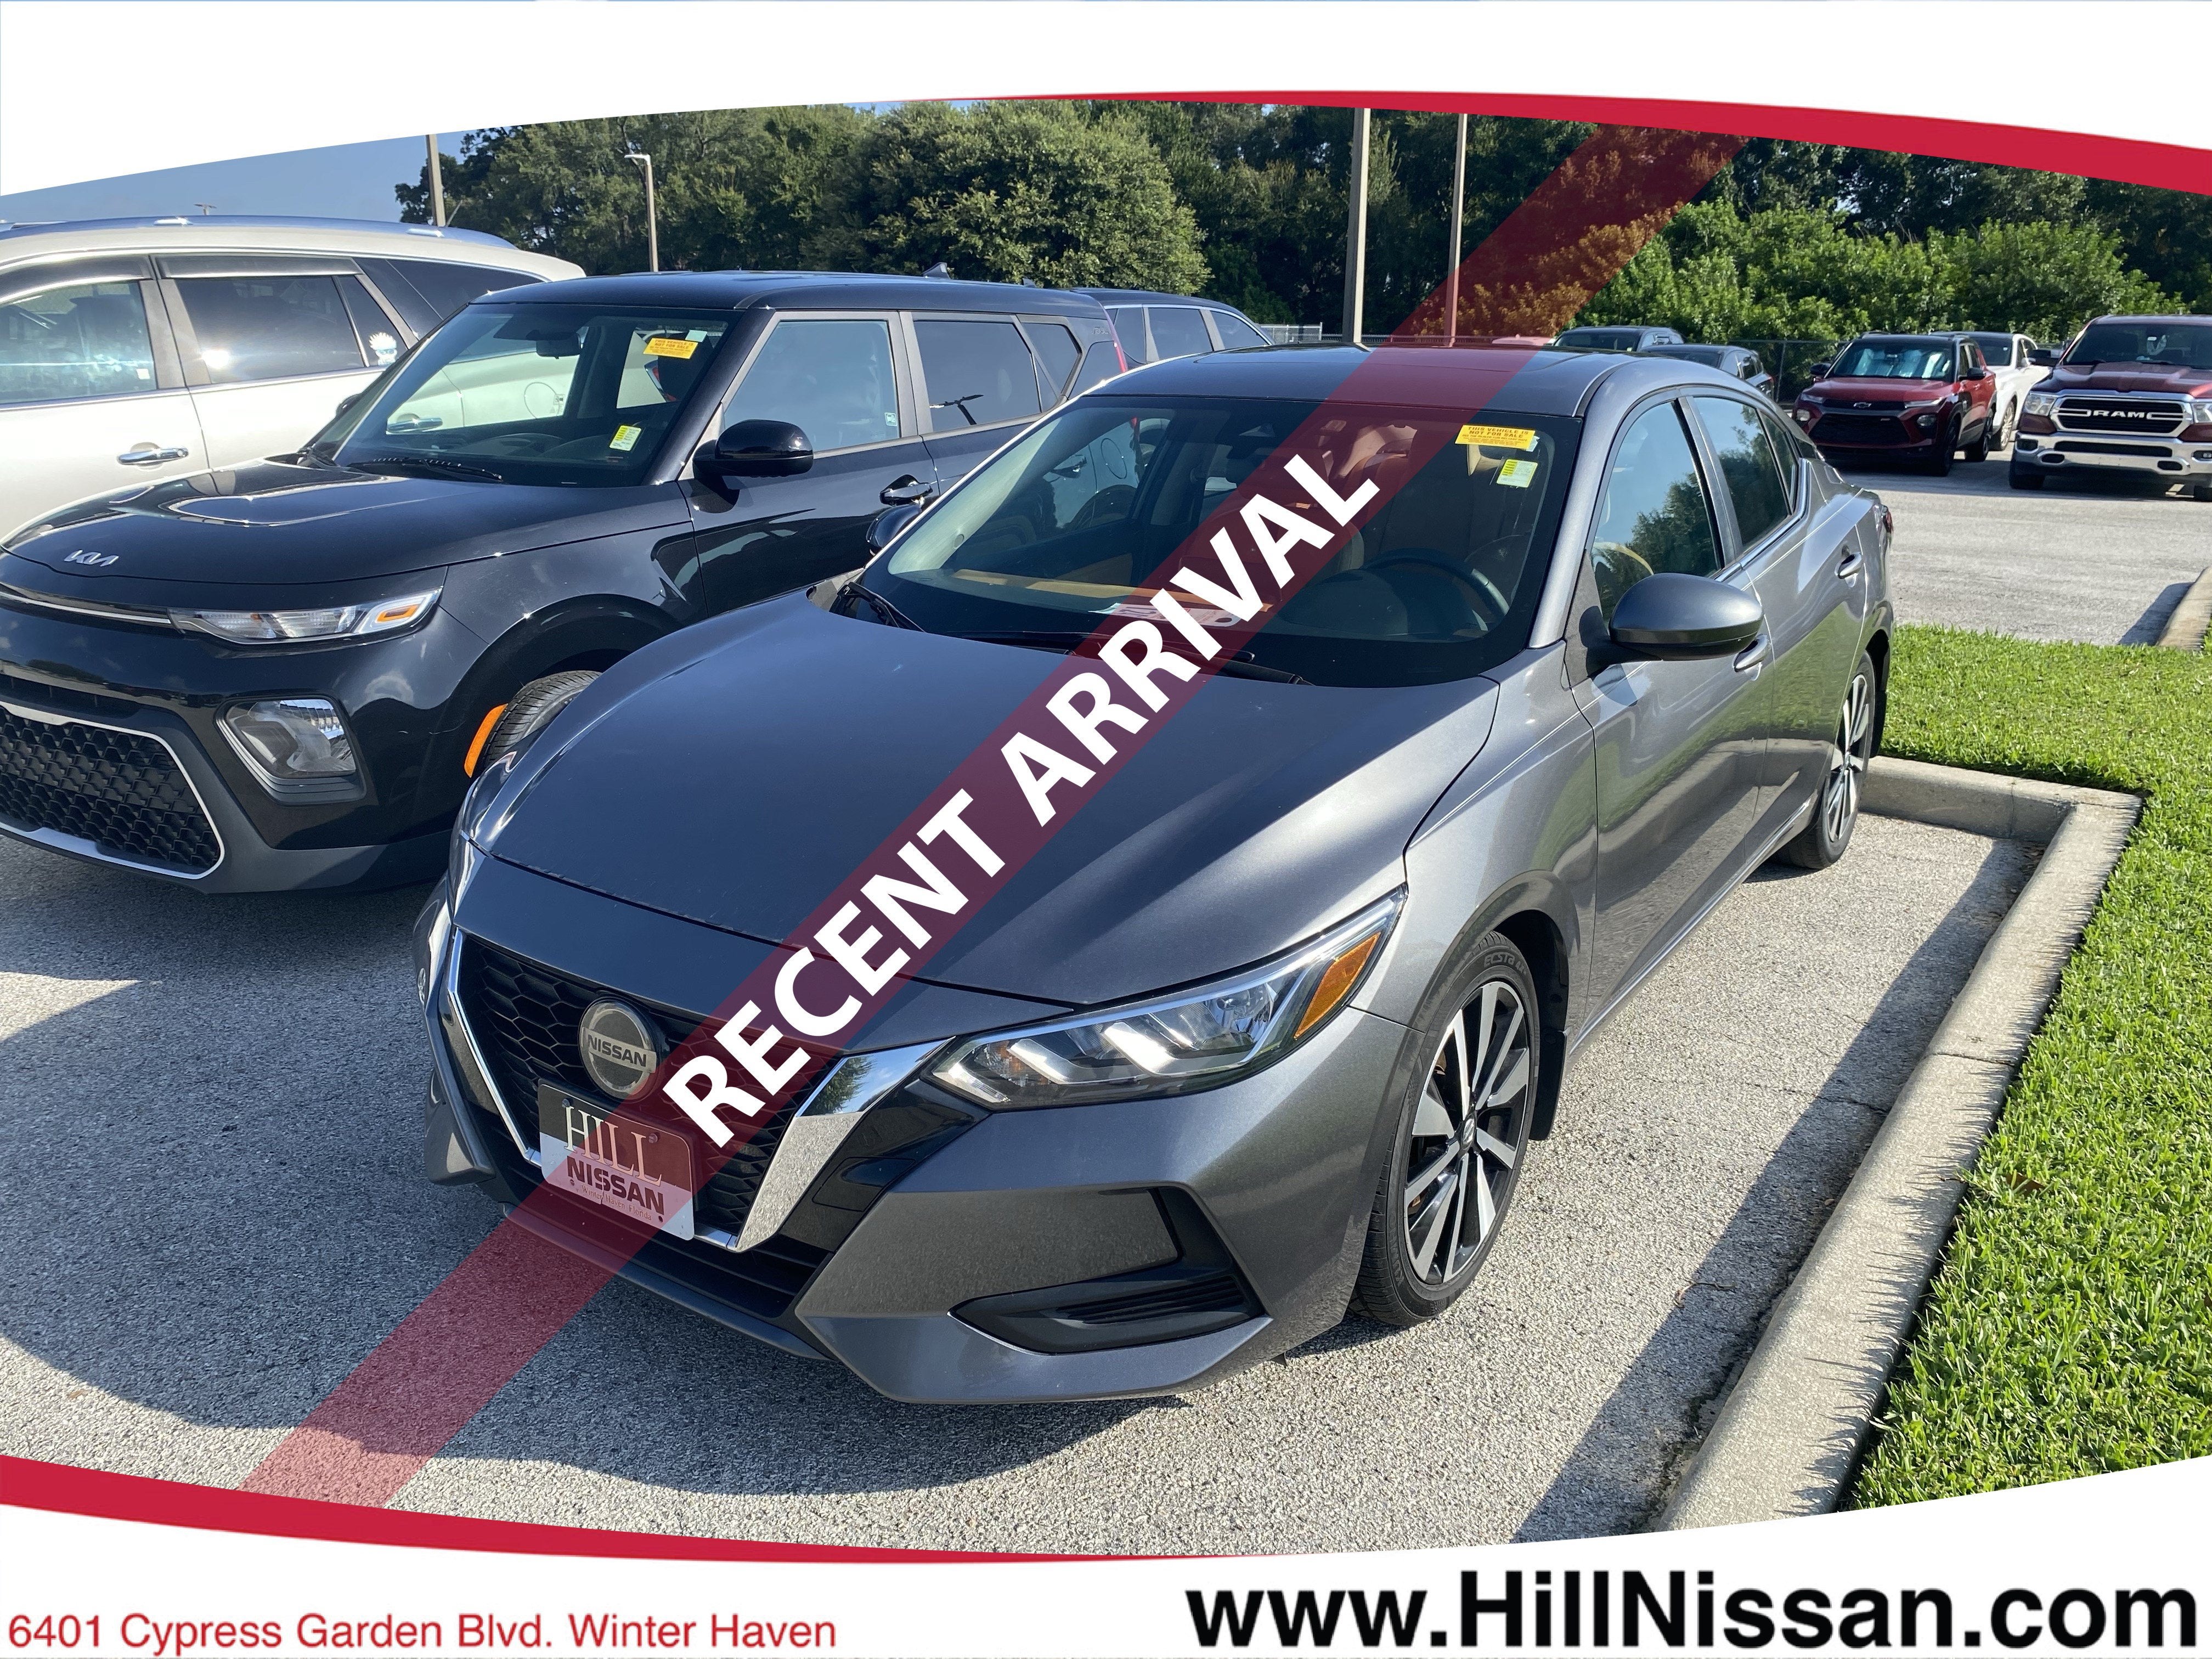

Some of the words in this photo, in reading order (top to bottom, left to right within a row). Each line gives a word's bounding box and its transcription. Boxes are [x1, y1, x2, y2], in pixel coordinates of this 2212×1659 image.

[2092, 410, 2145, 419] RAM
[587, 1034, 647, 1068] NISSAN
[563, 1104, 663, 1187] HILL
[567, 1155, 665, 1215] NISSAN
[582, 1184, 603, 1200] Winter
[606, 1193, 625, 1209] Haven
[629, 1204, 652, 1221] Florida
